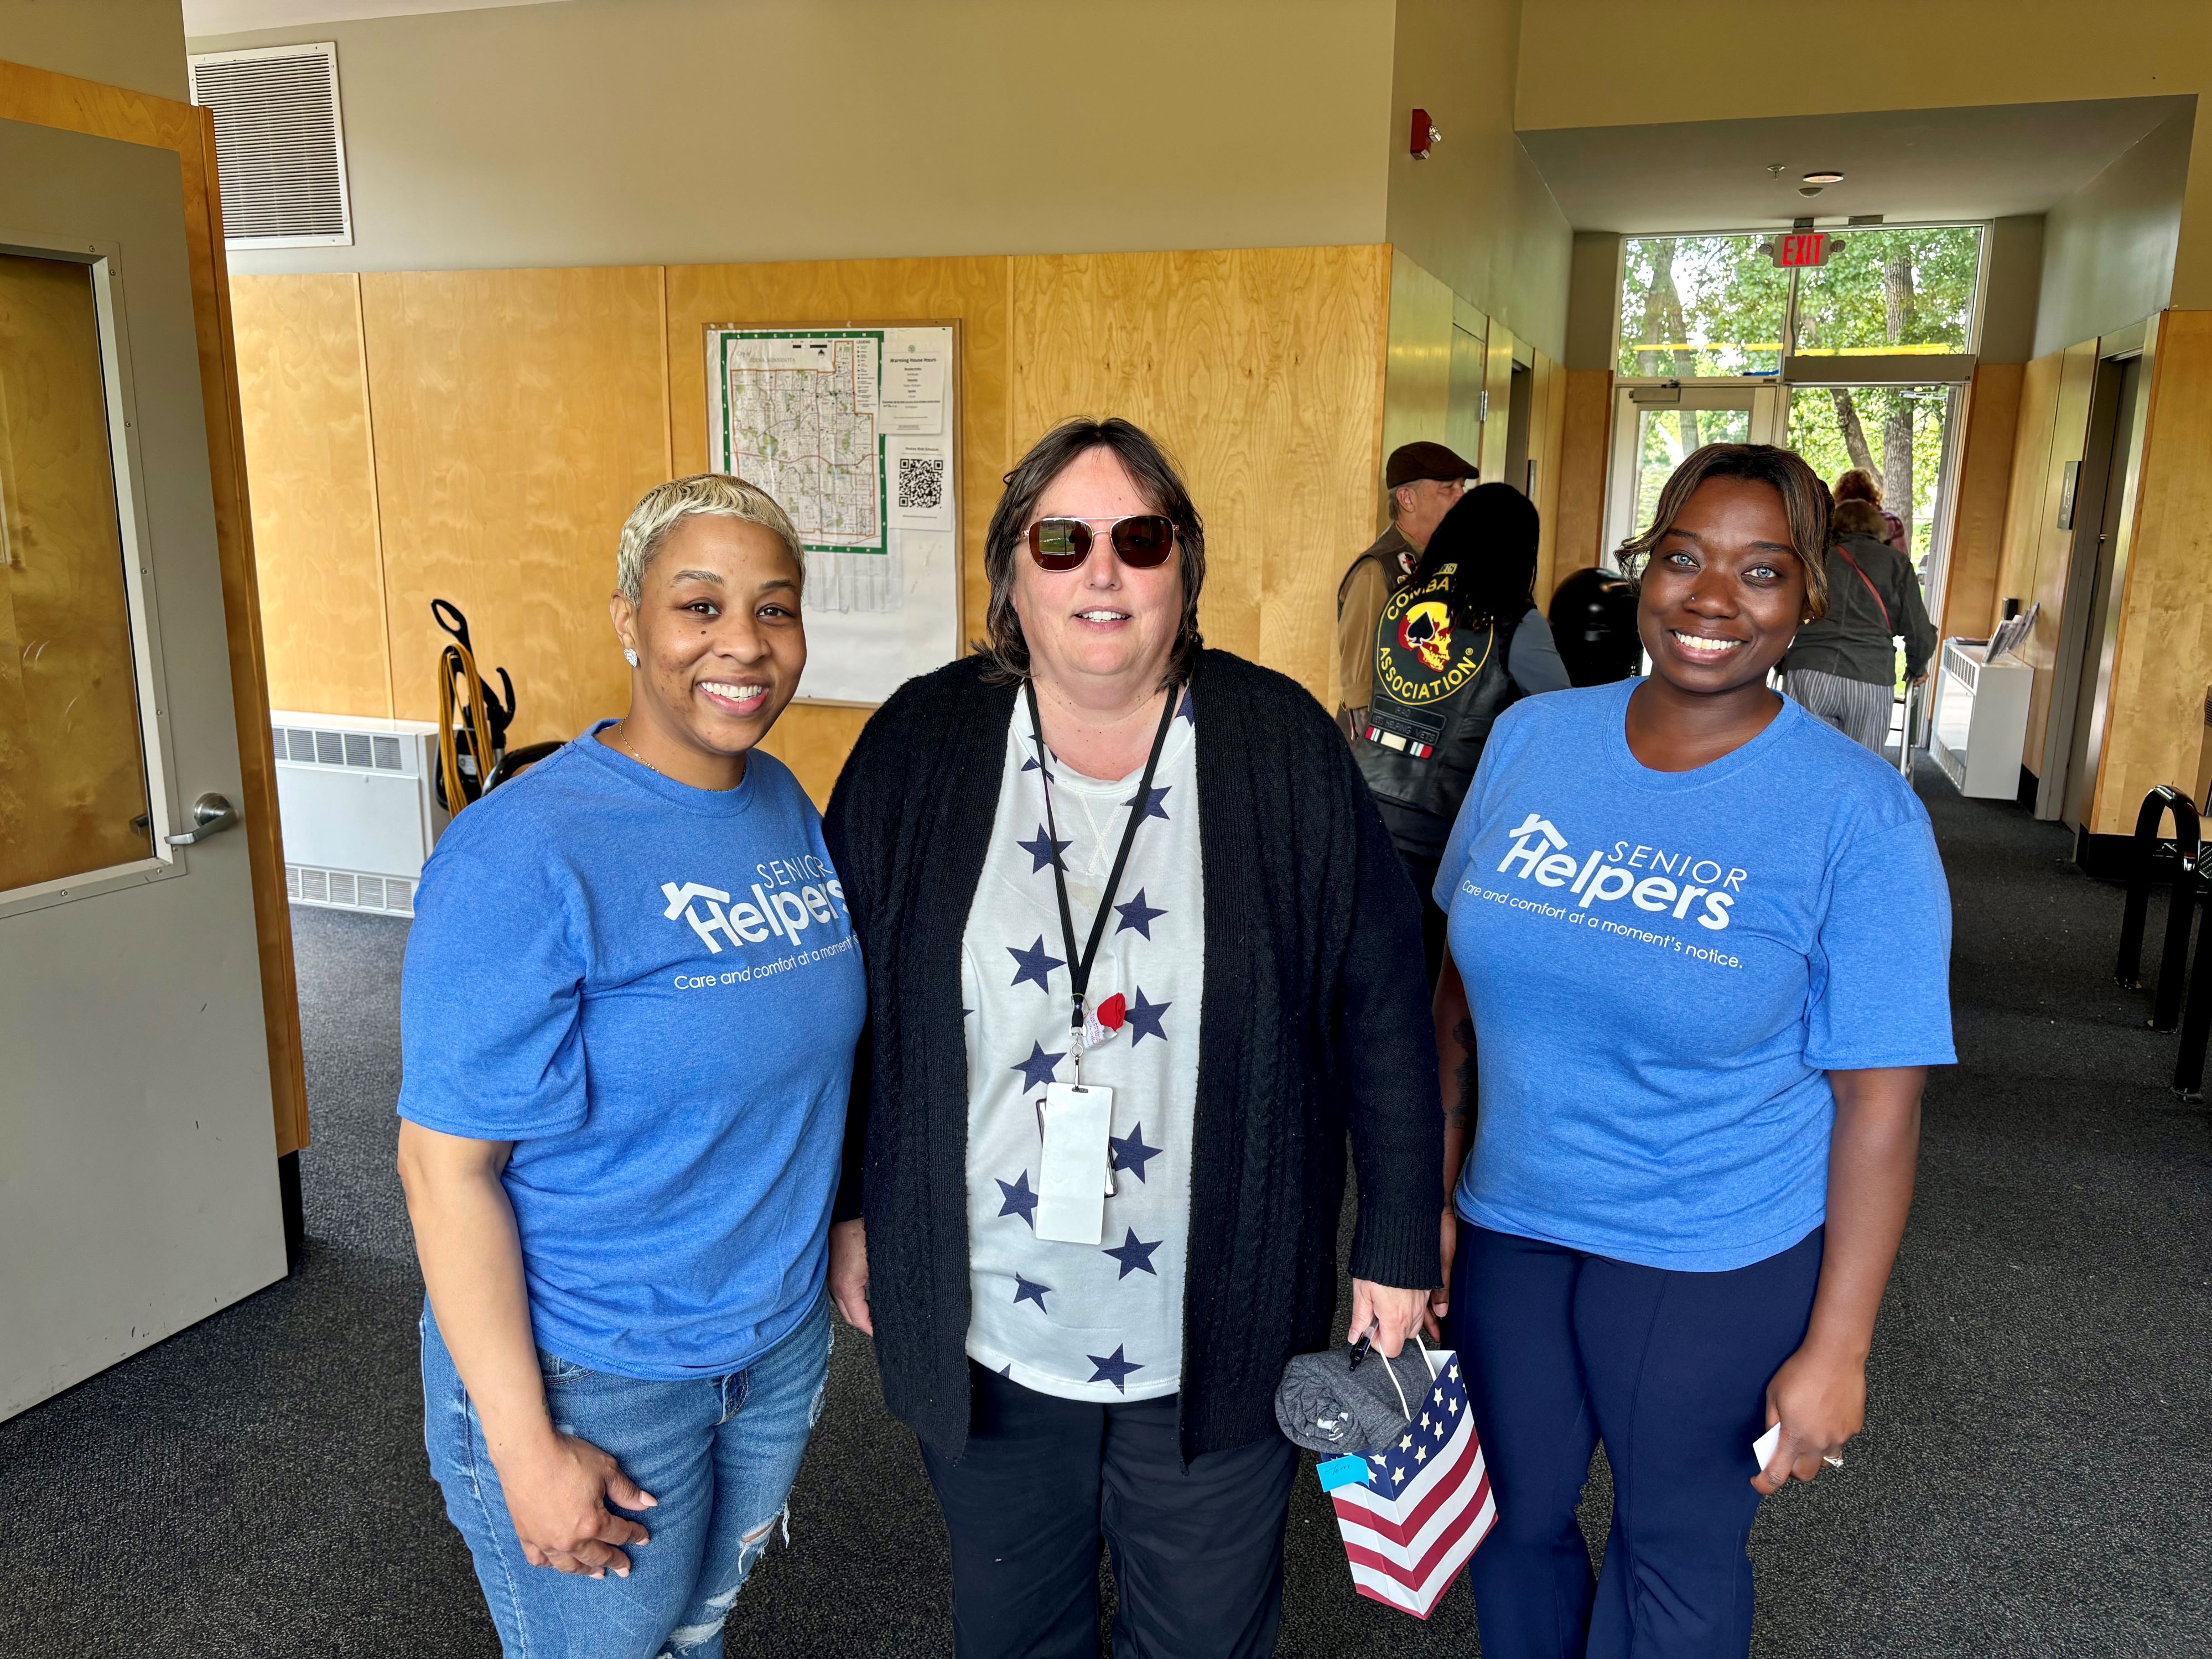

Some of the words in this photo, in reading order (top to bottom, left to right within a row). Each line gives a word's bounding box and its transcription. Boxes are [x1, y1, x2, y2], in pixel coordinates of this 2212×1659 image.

[1782, 235, 1824, 266] EXIT
[1415, 728, 1436, 743] VETS
[757, 854, 834, 889] SENIOR
[1496, 833, 1736, 930] Helpers
[1607, 840, 1748, 892] SENIOR
[1461, 880, 1482, 898] Care
[1483, 886, 1509, 904] and
[1510, 895, 1569, 920] comfort
[1568, 911, 1587, 925] at
[1587, 916, 1598, 928] a
[1601, 920, 1682, 952] moment's
[1685, 943, 1744, 969] notice.
[674, 974, 717, 990] Care
[720, 966, 750, 983] and
[753, 956, 797, 979] comfort
[798, 952, 809, 966] at
[812, 950, 821, 961] a
